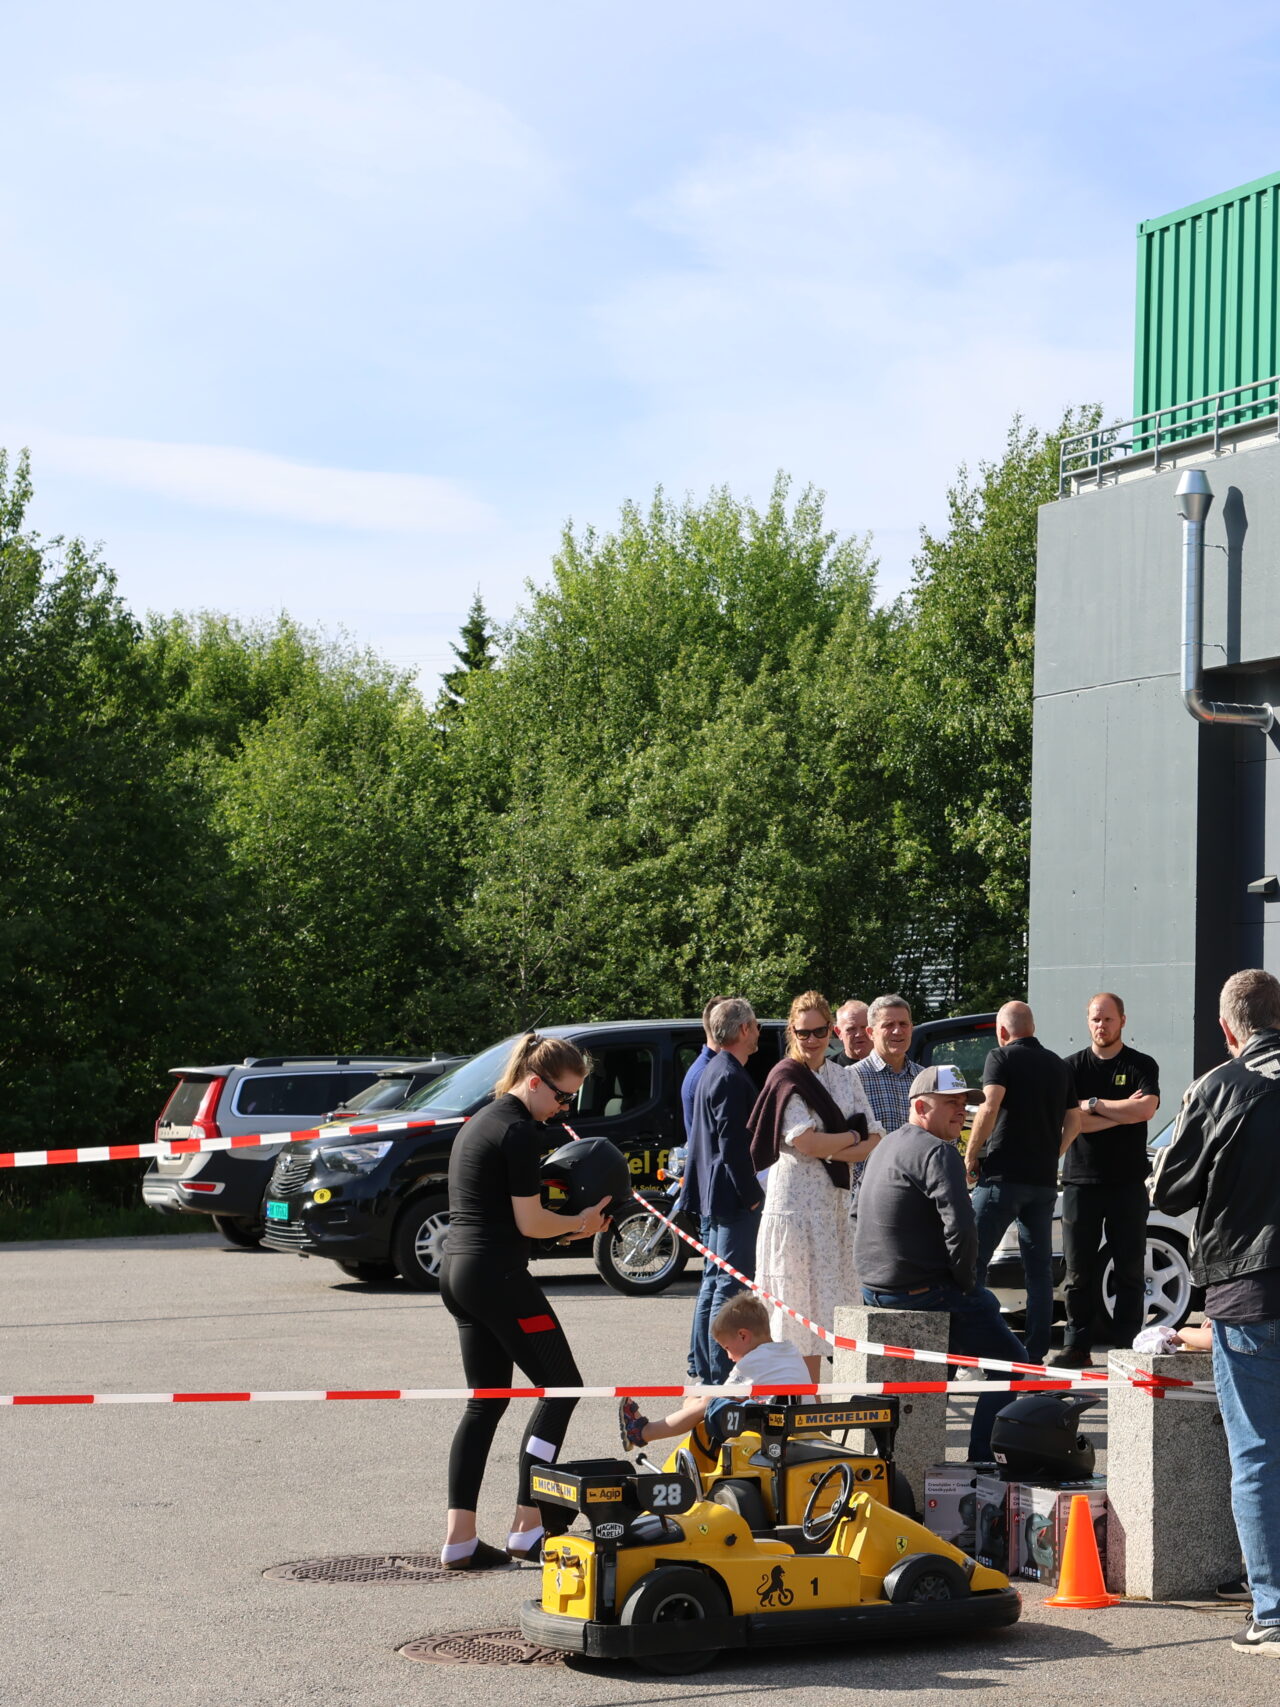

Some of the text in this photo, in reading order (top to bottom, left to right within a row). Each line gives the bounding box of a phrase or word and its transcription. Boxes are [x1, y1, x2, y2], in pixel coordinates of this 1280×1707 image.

[726, 1411, 740, 1431] 27
[805, 1410, 879, 1425] MICHELIN
[873, 1464, 885, 1481] 2
[599, 1487, 621, 1501] Agip
[652, 1483, 682, 1507] 28
[810, 1576, 819, 1597] 1
